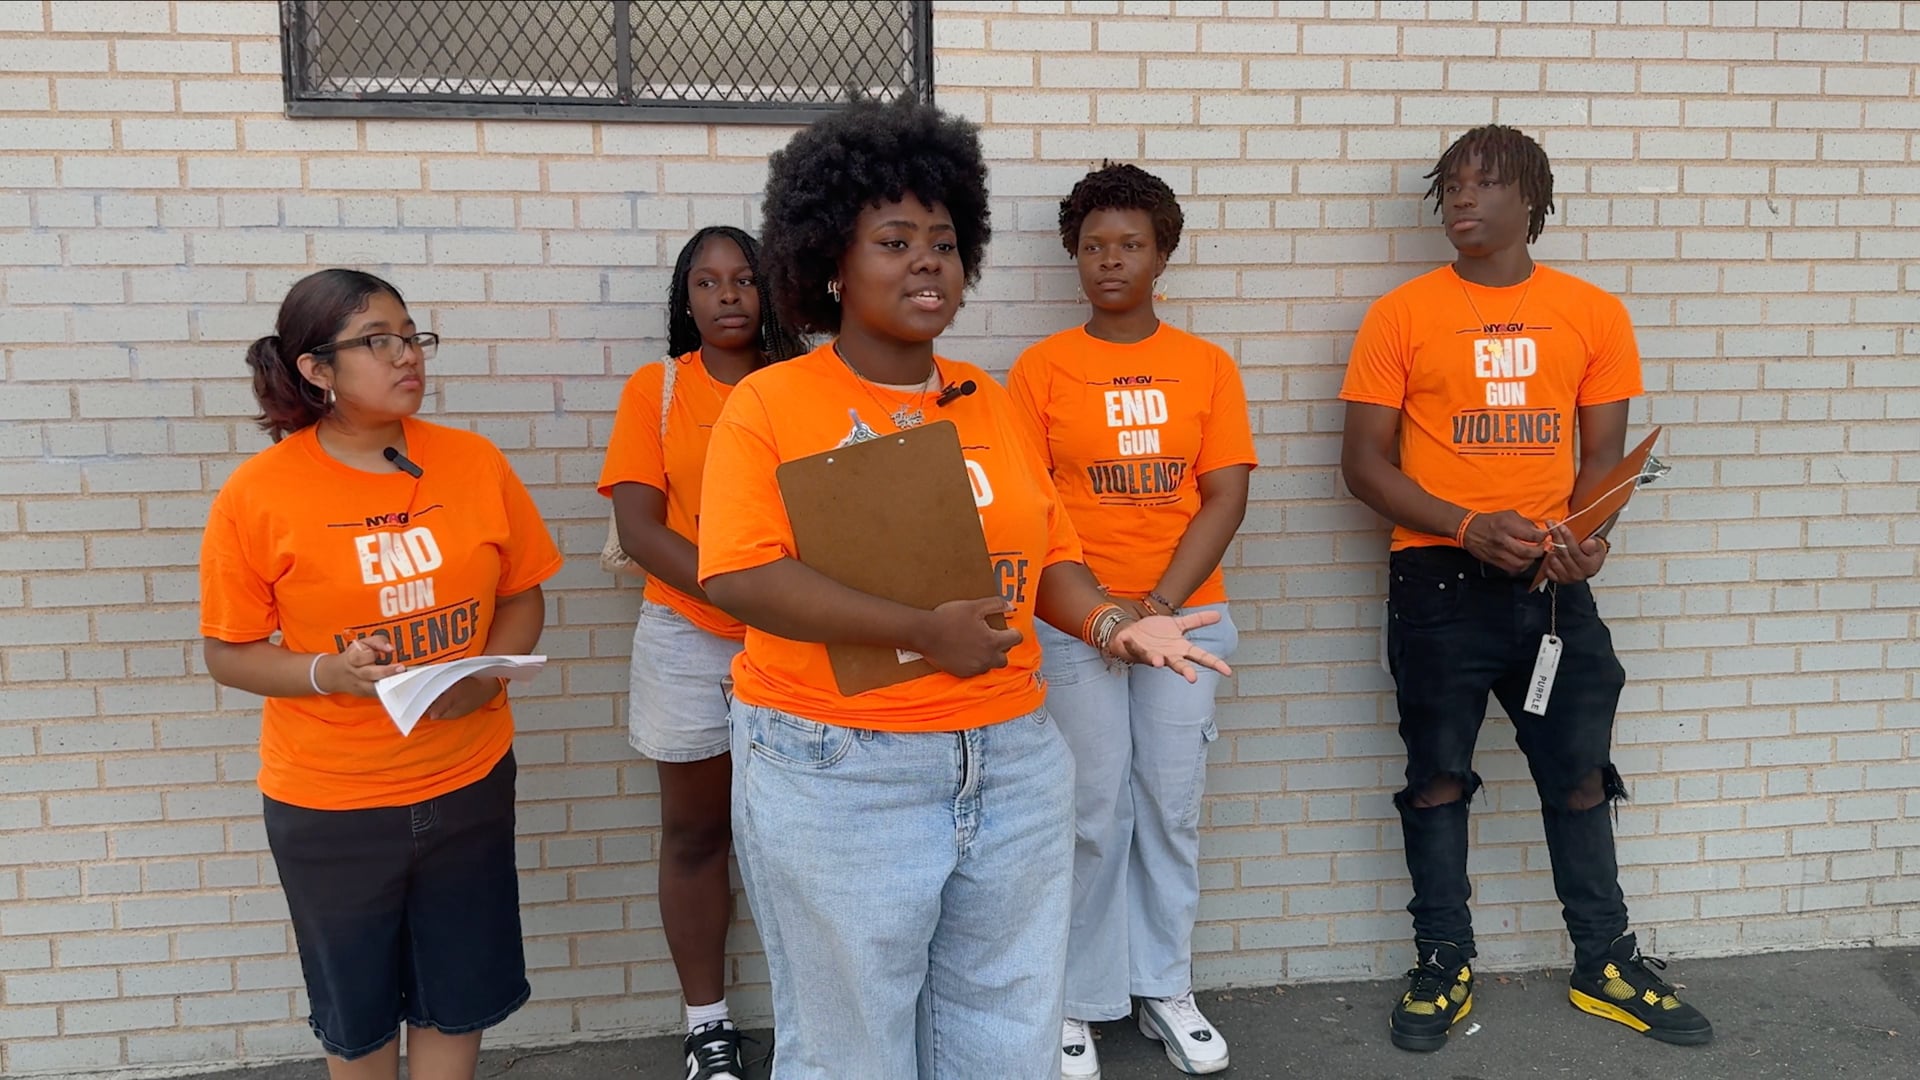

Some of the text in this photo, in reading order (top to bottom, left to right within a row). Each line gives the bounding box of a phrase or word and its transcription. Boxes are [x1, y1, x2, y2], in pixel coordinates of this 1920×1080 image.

[1483, 323, 1524, 333] NYAGV
[1474, 337, 1537, 378] END
[1113, 376, 1152, 385] NYAGV
[1486, 381, 1526, 406] GUN
[1104, 389, 1168, 427] END
[1118, 429, 1160, 456] GUN
[1452, 413, 1561, 444] VIOLENCE
[366, 511, 409, 527] NYAG
[355, 527, 443, 585] END
[379, 577, 435, 617] GUN
[334, 601, 480, 666] OLENCE
[1531, 674, 1547, 710] PURPLE
